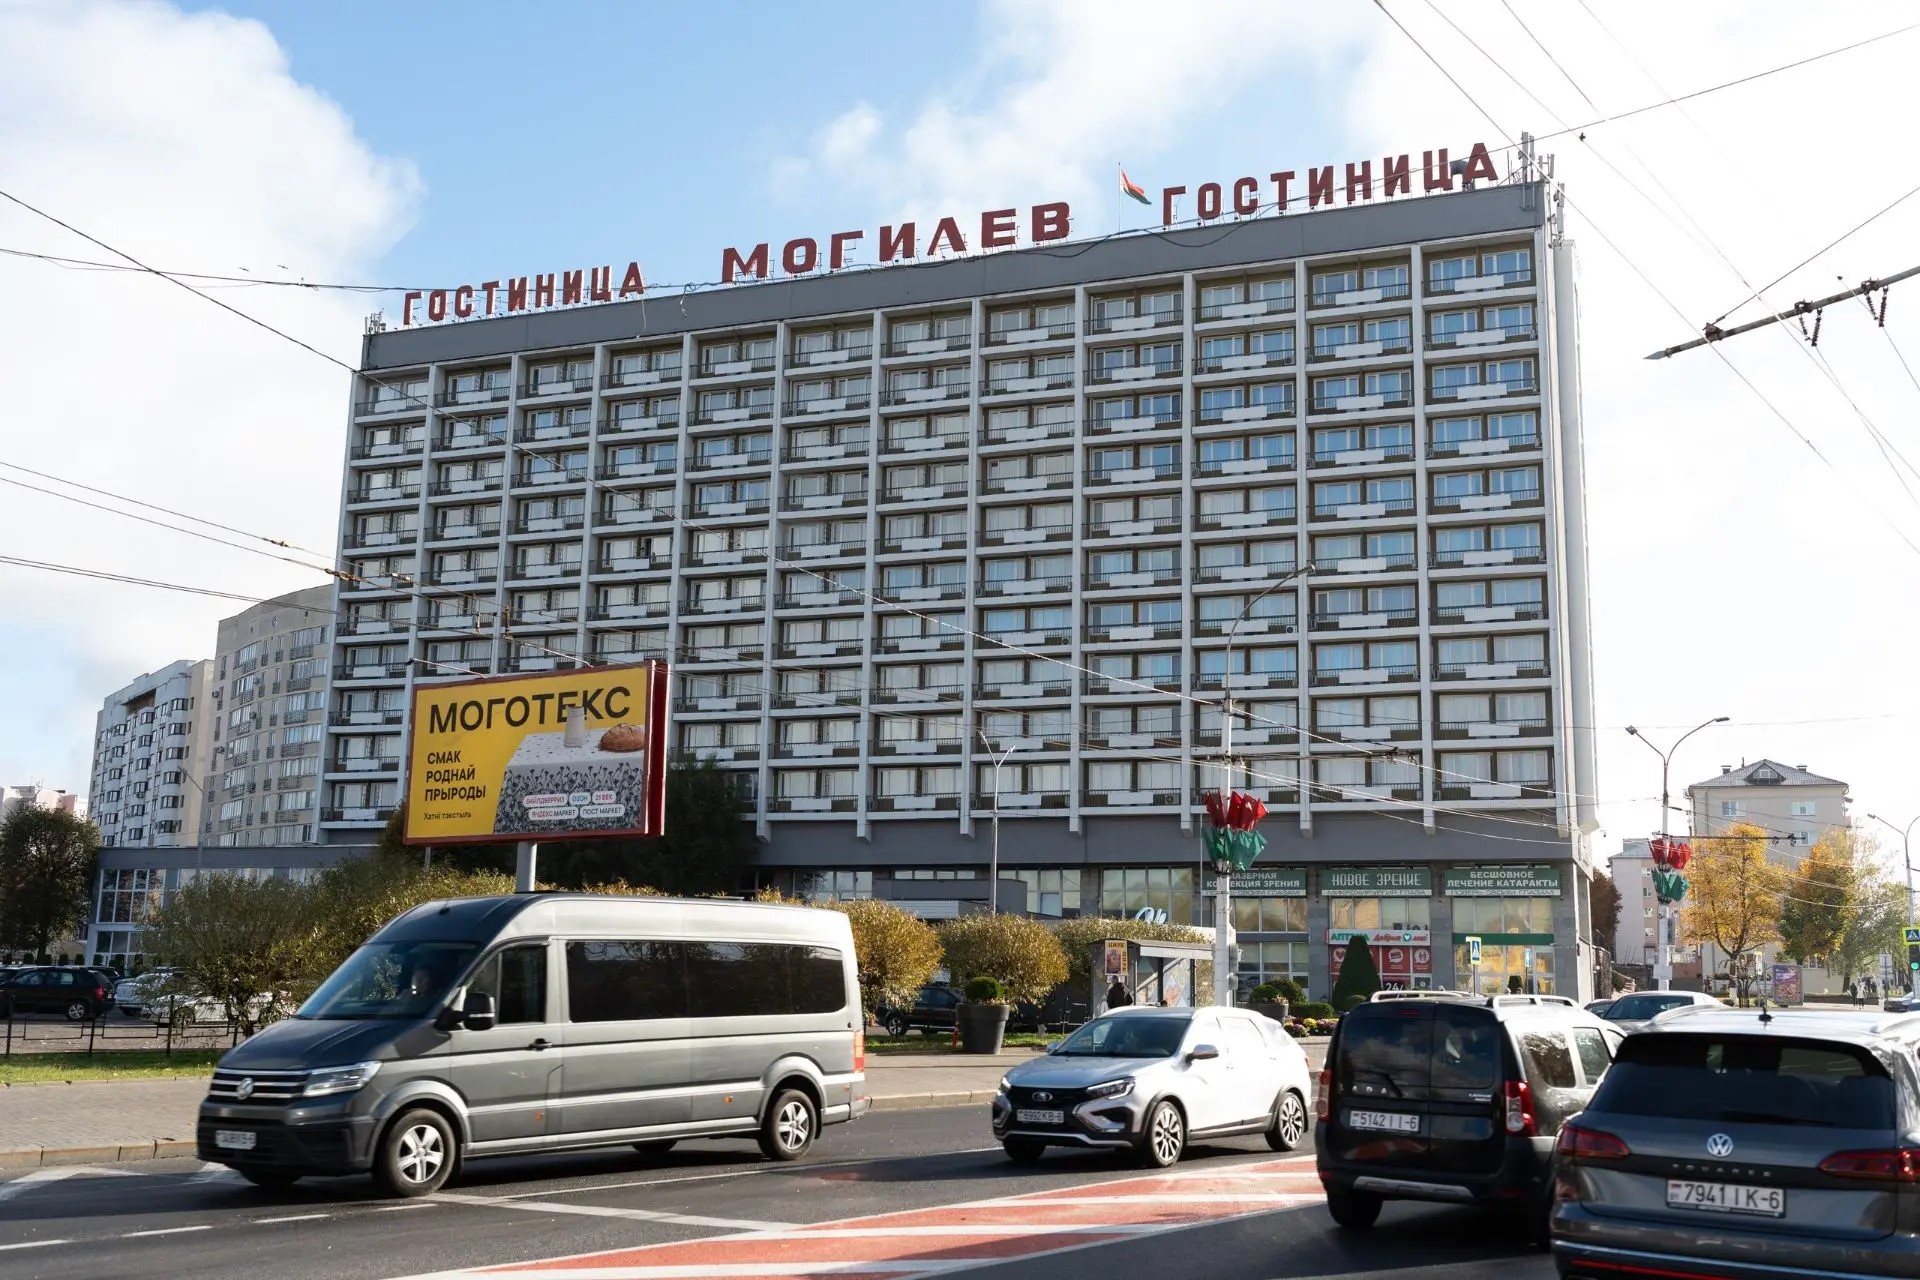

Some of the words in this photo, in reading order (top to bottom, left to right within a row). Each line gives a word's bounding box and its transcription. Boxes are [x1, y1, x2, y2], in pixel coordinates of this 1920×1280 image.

[1163, 142, 1498, 225] ГОСТИНИЦА
[721, 201, 1070, 283] МОГИЛЕВ
[403, 261, 645, 325] ГОСТИНИЦА
[429, 686, 631, 734] МОГОТЕКС
[427, 750, 461, 764] СМАК
[426, 764, 475, 784] РОДНАЙ
[425, 785, 486, 801] ПРЫРОДЫ
[1332, 873, 1370, 886] НОВОЕ
[1376, 873, 1422, 886] ЗРЕНИЕ
[1447, 879, 1494, 887] ЛЕЧЕНИЕ
[1496, 879, 1558, 887] КАТАРАКТЫ
[1470, 871, 1534, 879] БЕСШОВНОЕ
[1263, 880, 1300, 888] ЗРЕНИЯ
[1331, 932, 1370, 941] АПТА
[1684, 1183, 1725, 1204] 7941
